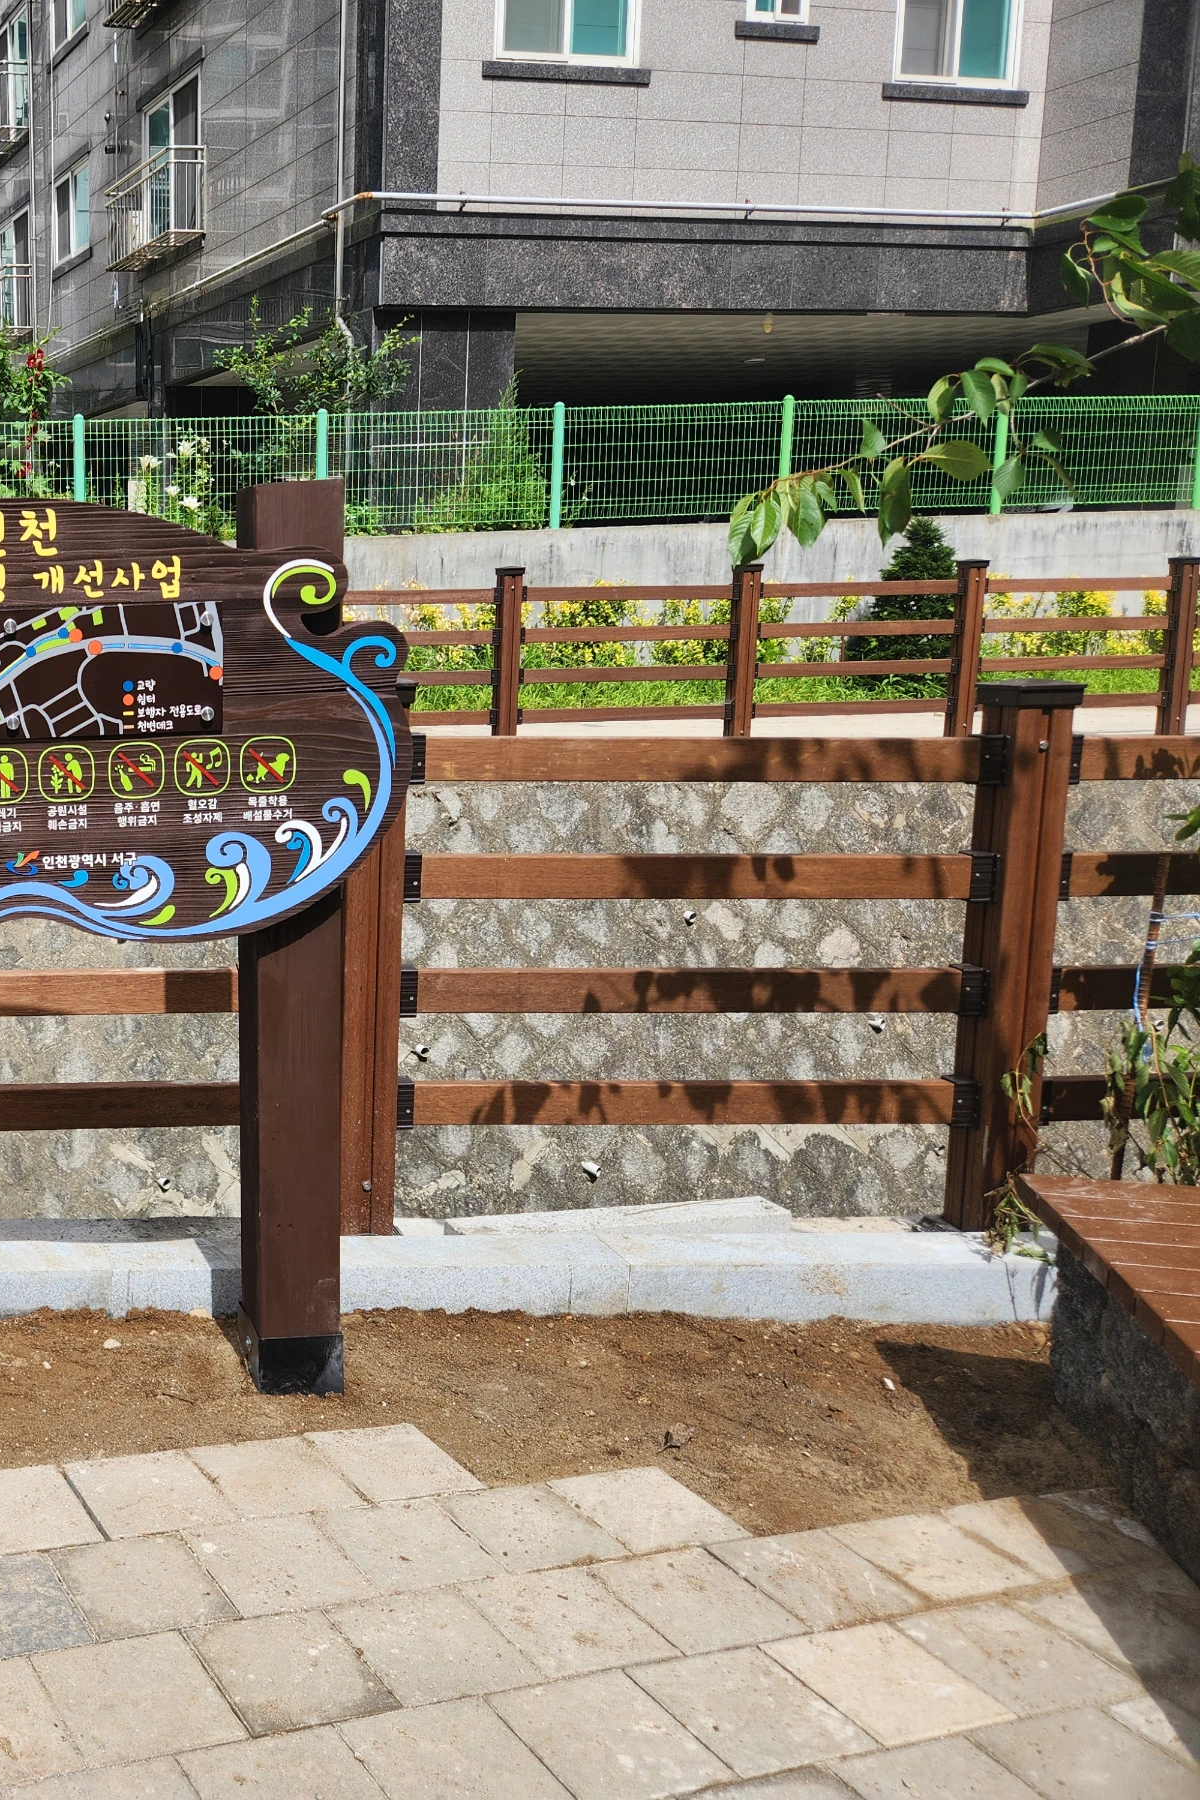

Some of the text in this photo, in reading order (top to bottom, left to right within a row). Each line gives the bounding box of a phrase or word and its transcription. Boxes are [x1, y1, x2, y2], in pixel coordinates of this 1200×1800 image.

[33, 555, 181, 599] 개선사업
[137, 704, 202, 718] 보행자 전용도로
[137, 720, 173, 732] 천변데크
[47, 804, 88, 818] 공원시설
[182, 811, 223, 824] 조성자제
[117, 814, 158, 828] 행위금지
[42, 852, 138, 870] 인천광역시 서구
